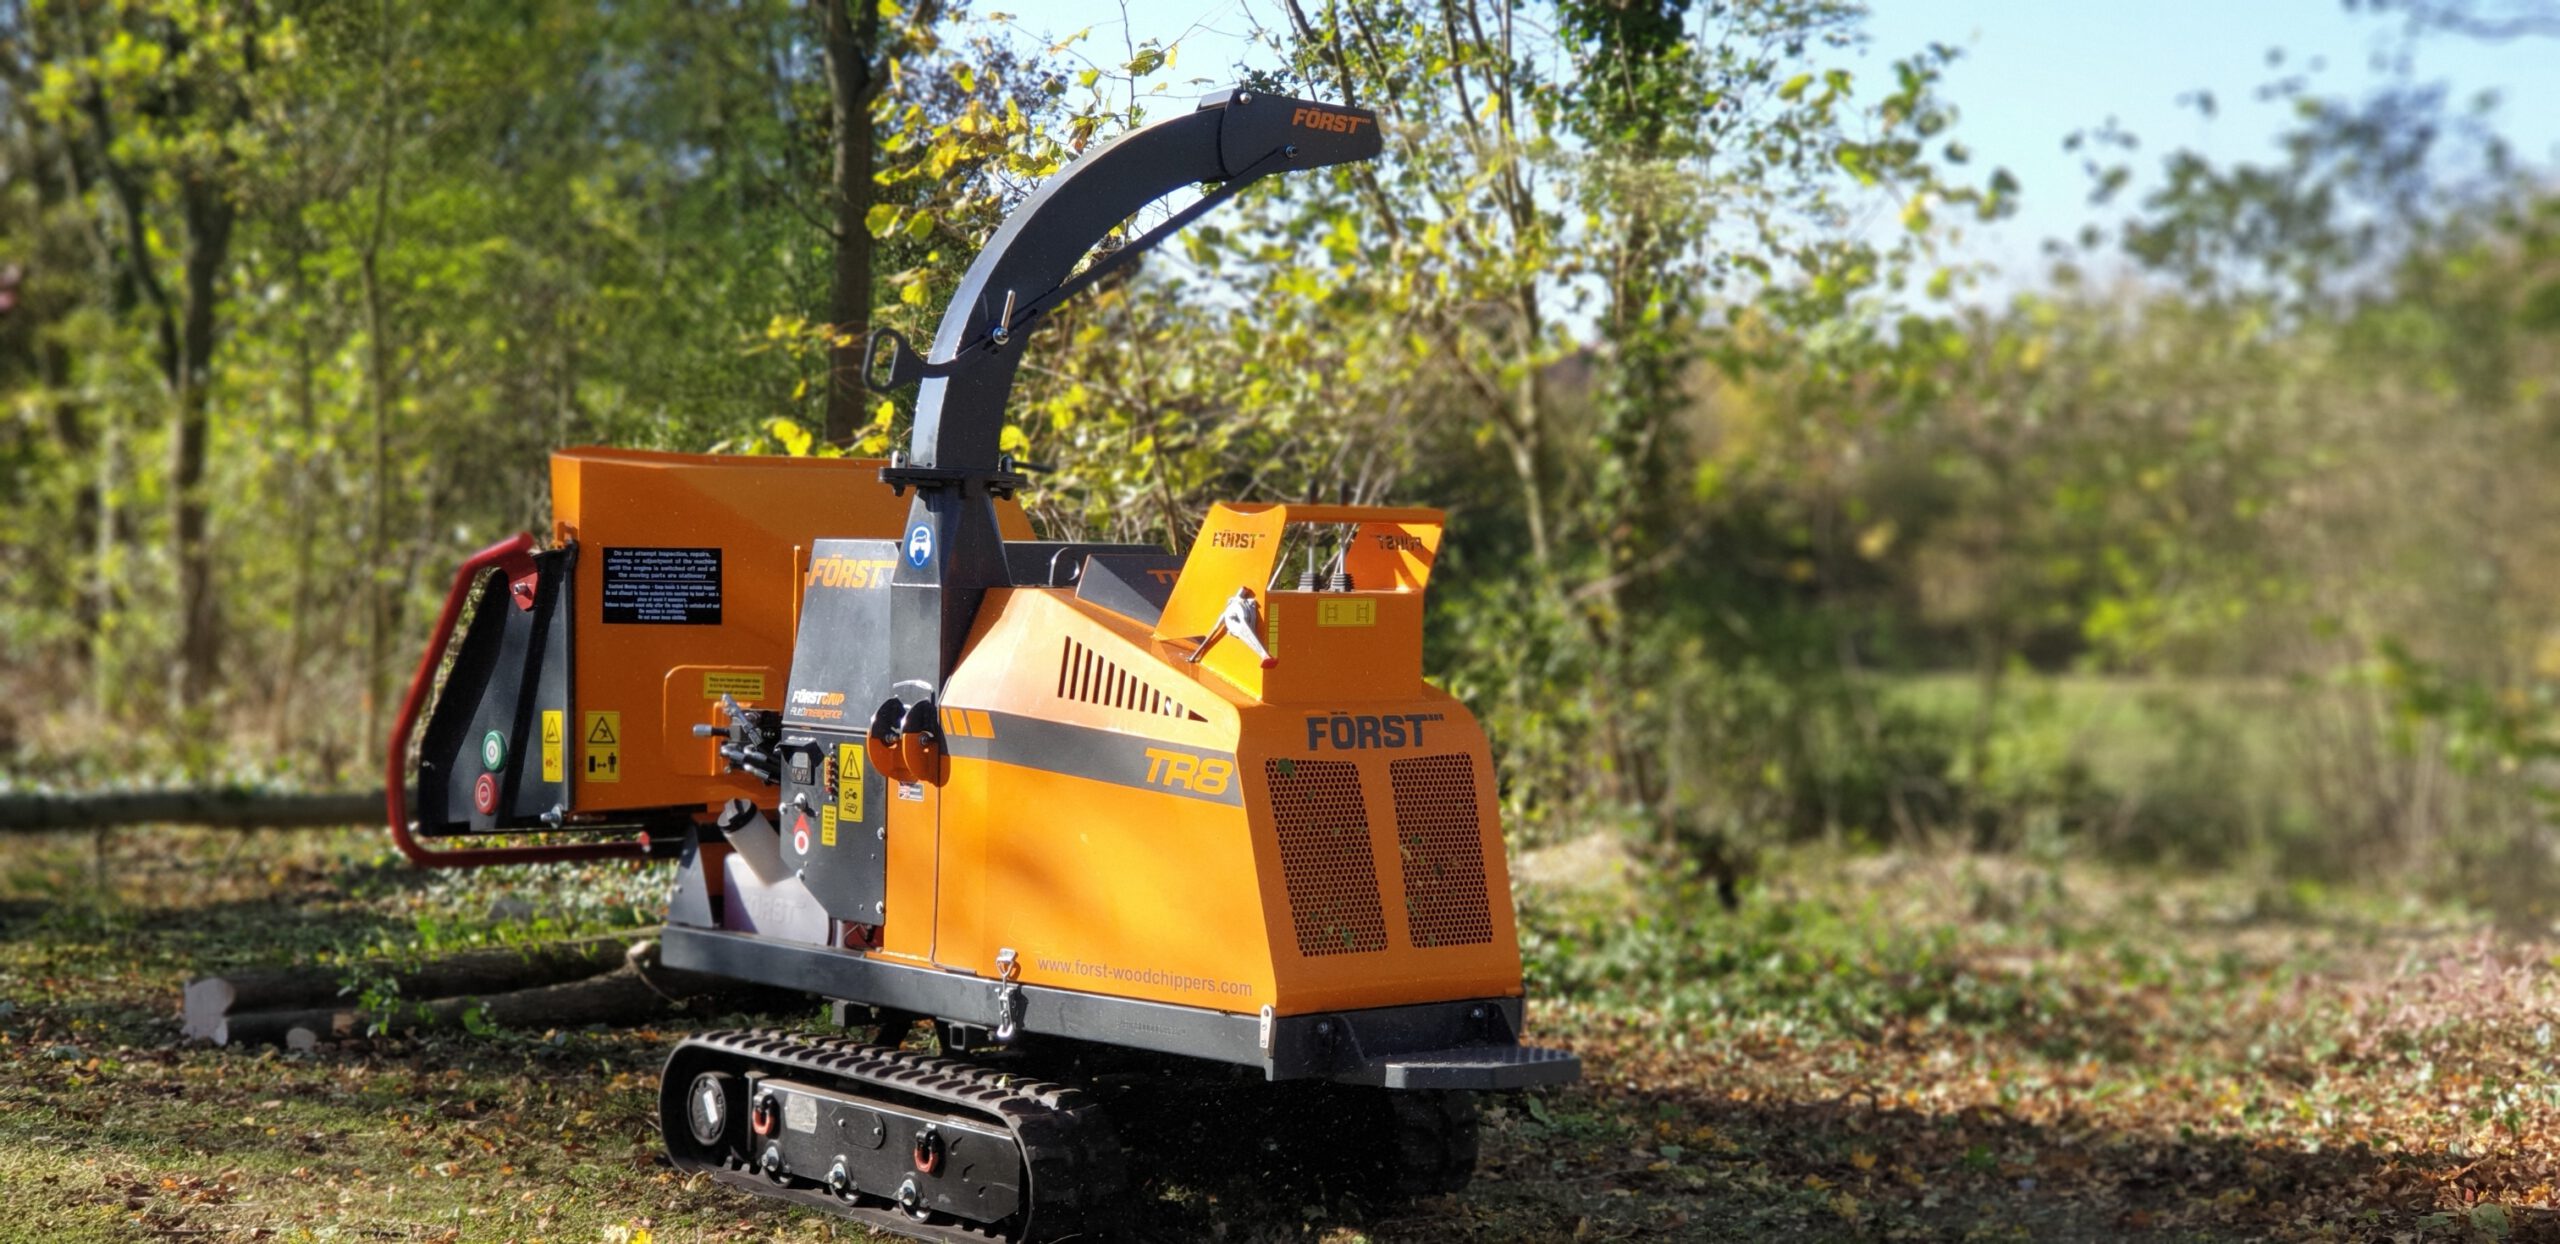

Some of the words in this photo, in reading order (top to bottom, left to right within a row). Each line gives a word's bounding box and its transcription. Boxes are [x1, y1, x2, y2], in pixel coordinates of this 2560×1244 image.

[1292, 107, 1363, 134] FÖRST
[808, 554, 898, 588] FÖRST
[1306, 711, 1427, 751] FÖRST
[1145, 747, 1233, 795] TR8
[1037, 957, 1253, 997] www.forst-woodchippers.com
